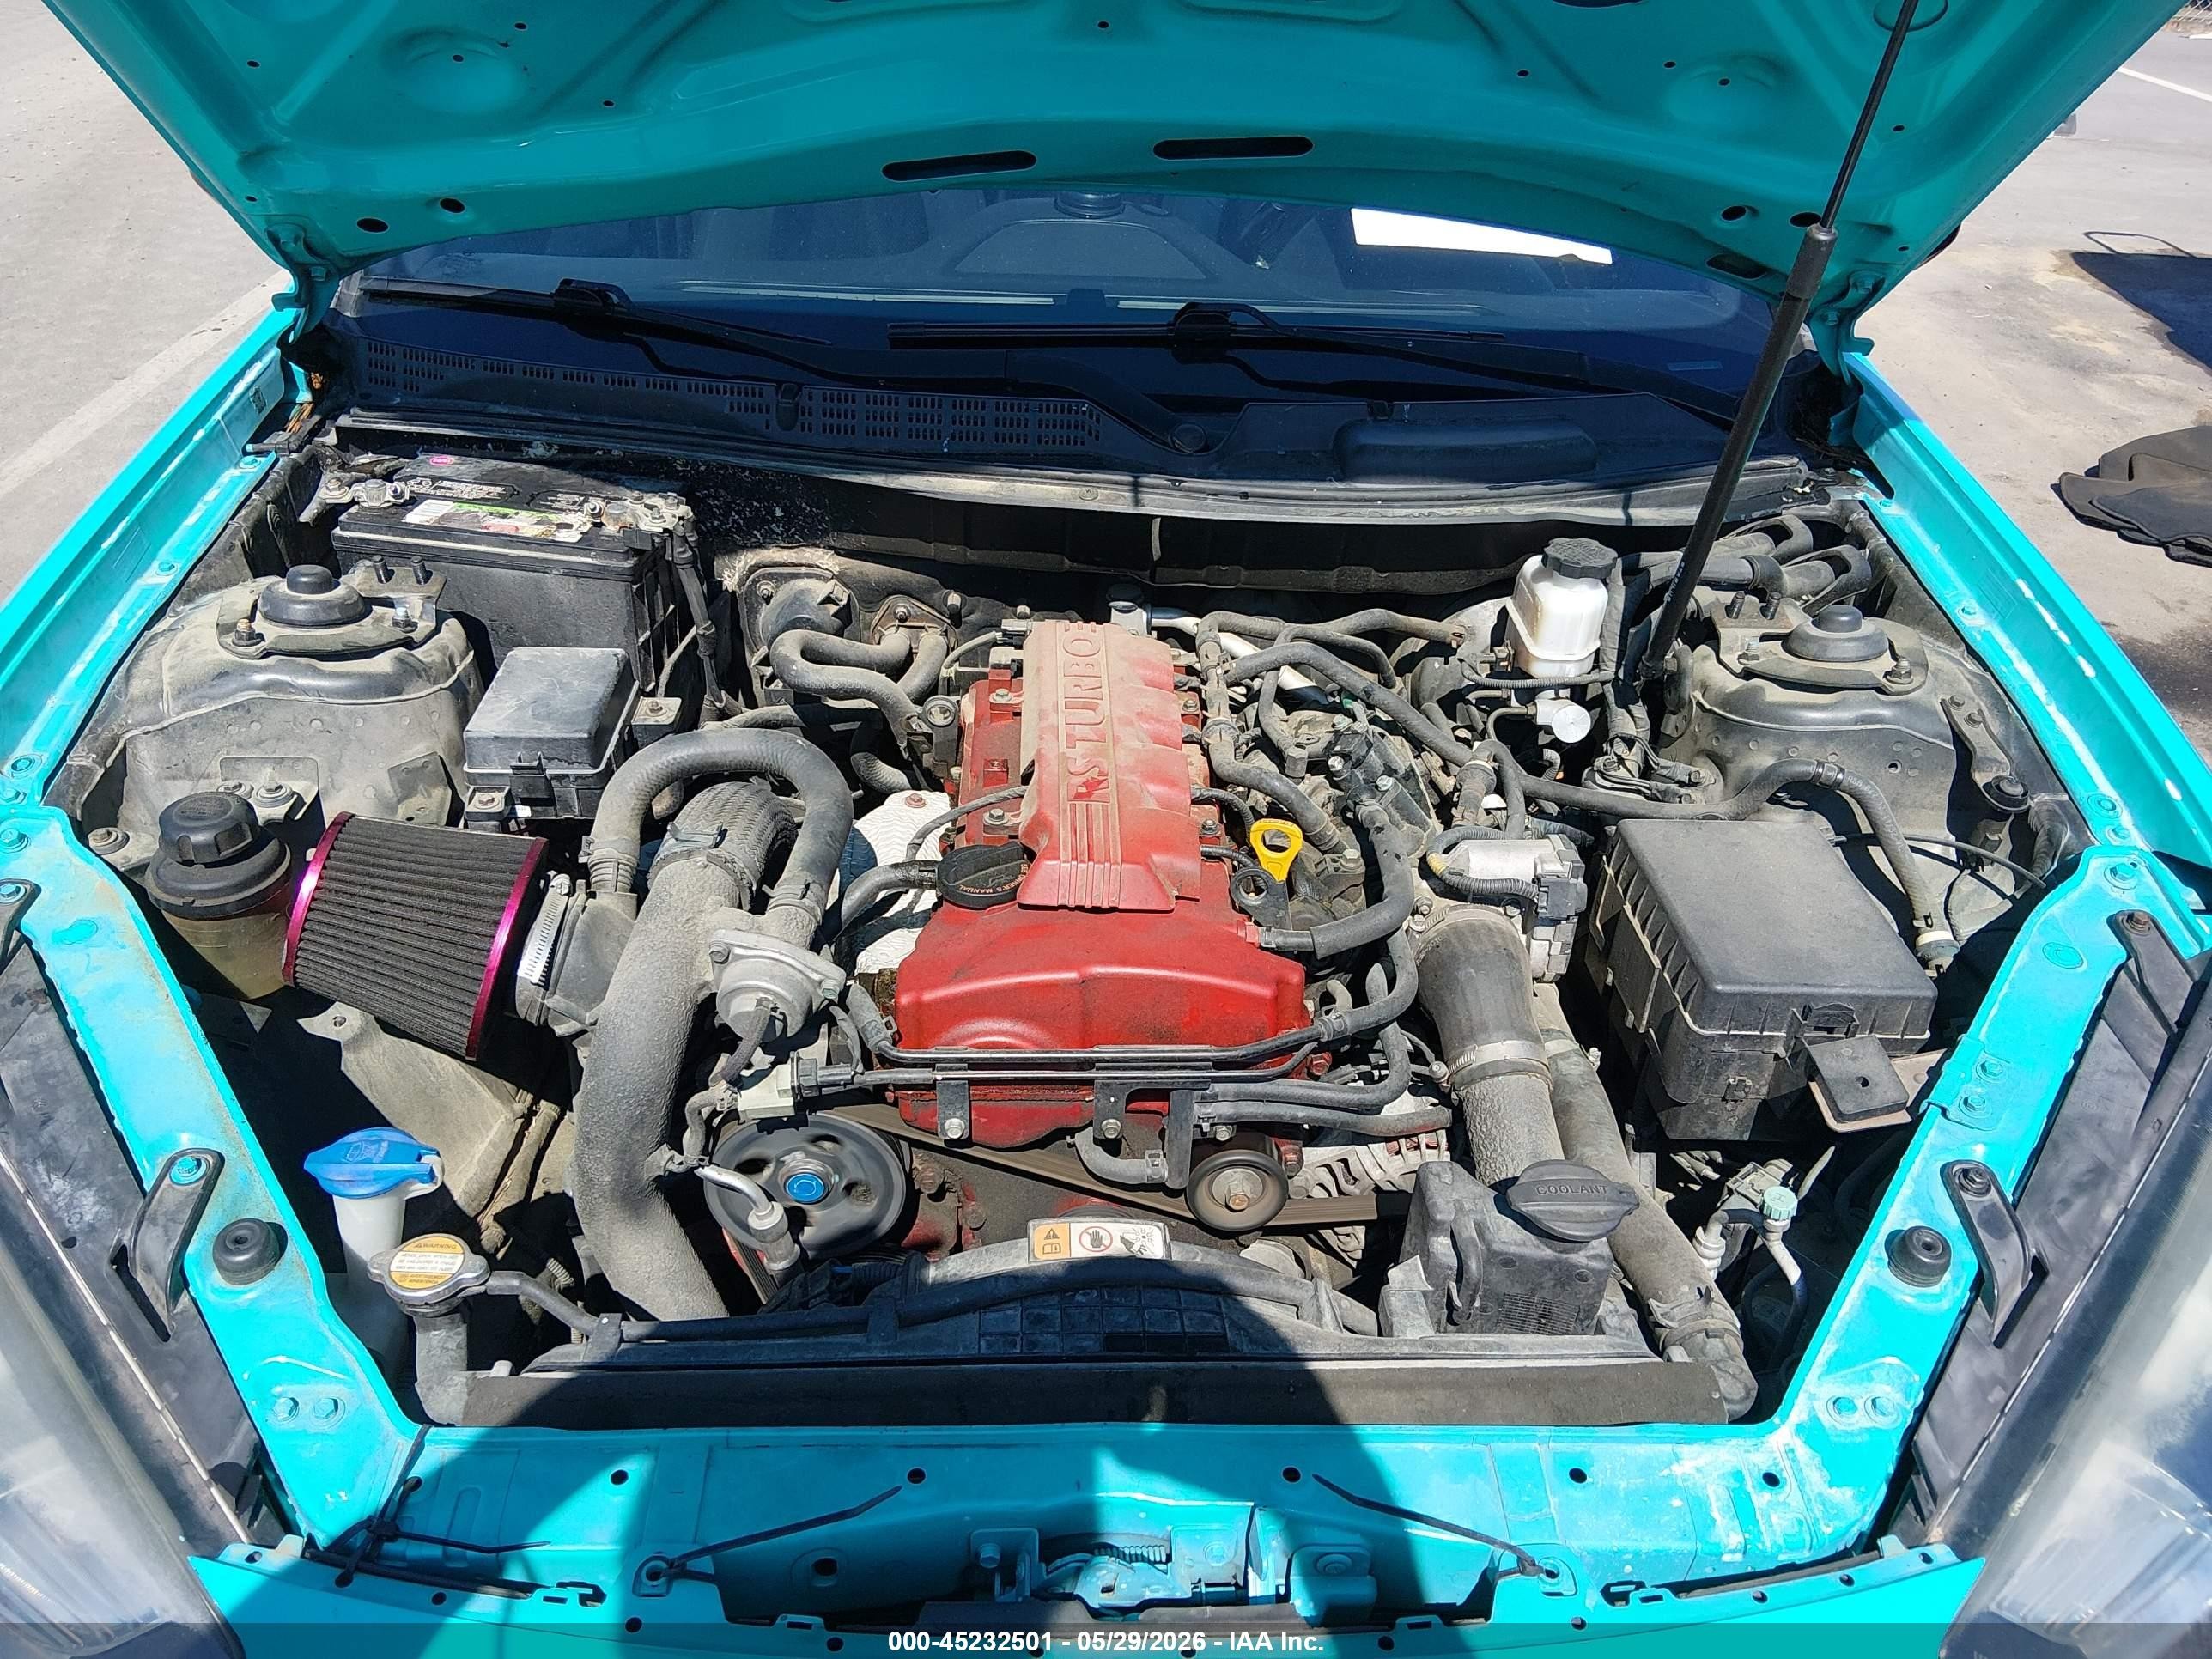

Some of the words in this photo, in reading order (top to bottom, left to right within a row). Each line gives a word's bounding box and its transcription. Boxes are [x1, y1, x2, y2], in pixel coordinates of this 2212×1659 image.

[996, 873, 1027, 892] OWNER'S
[958, 884, 994, 895] MANUAL
[1534, 1184, 1608, 1196] COOLANT
